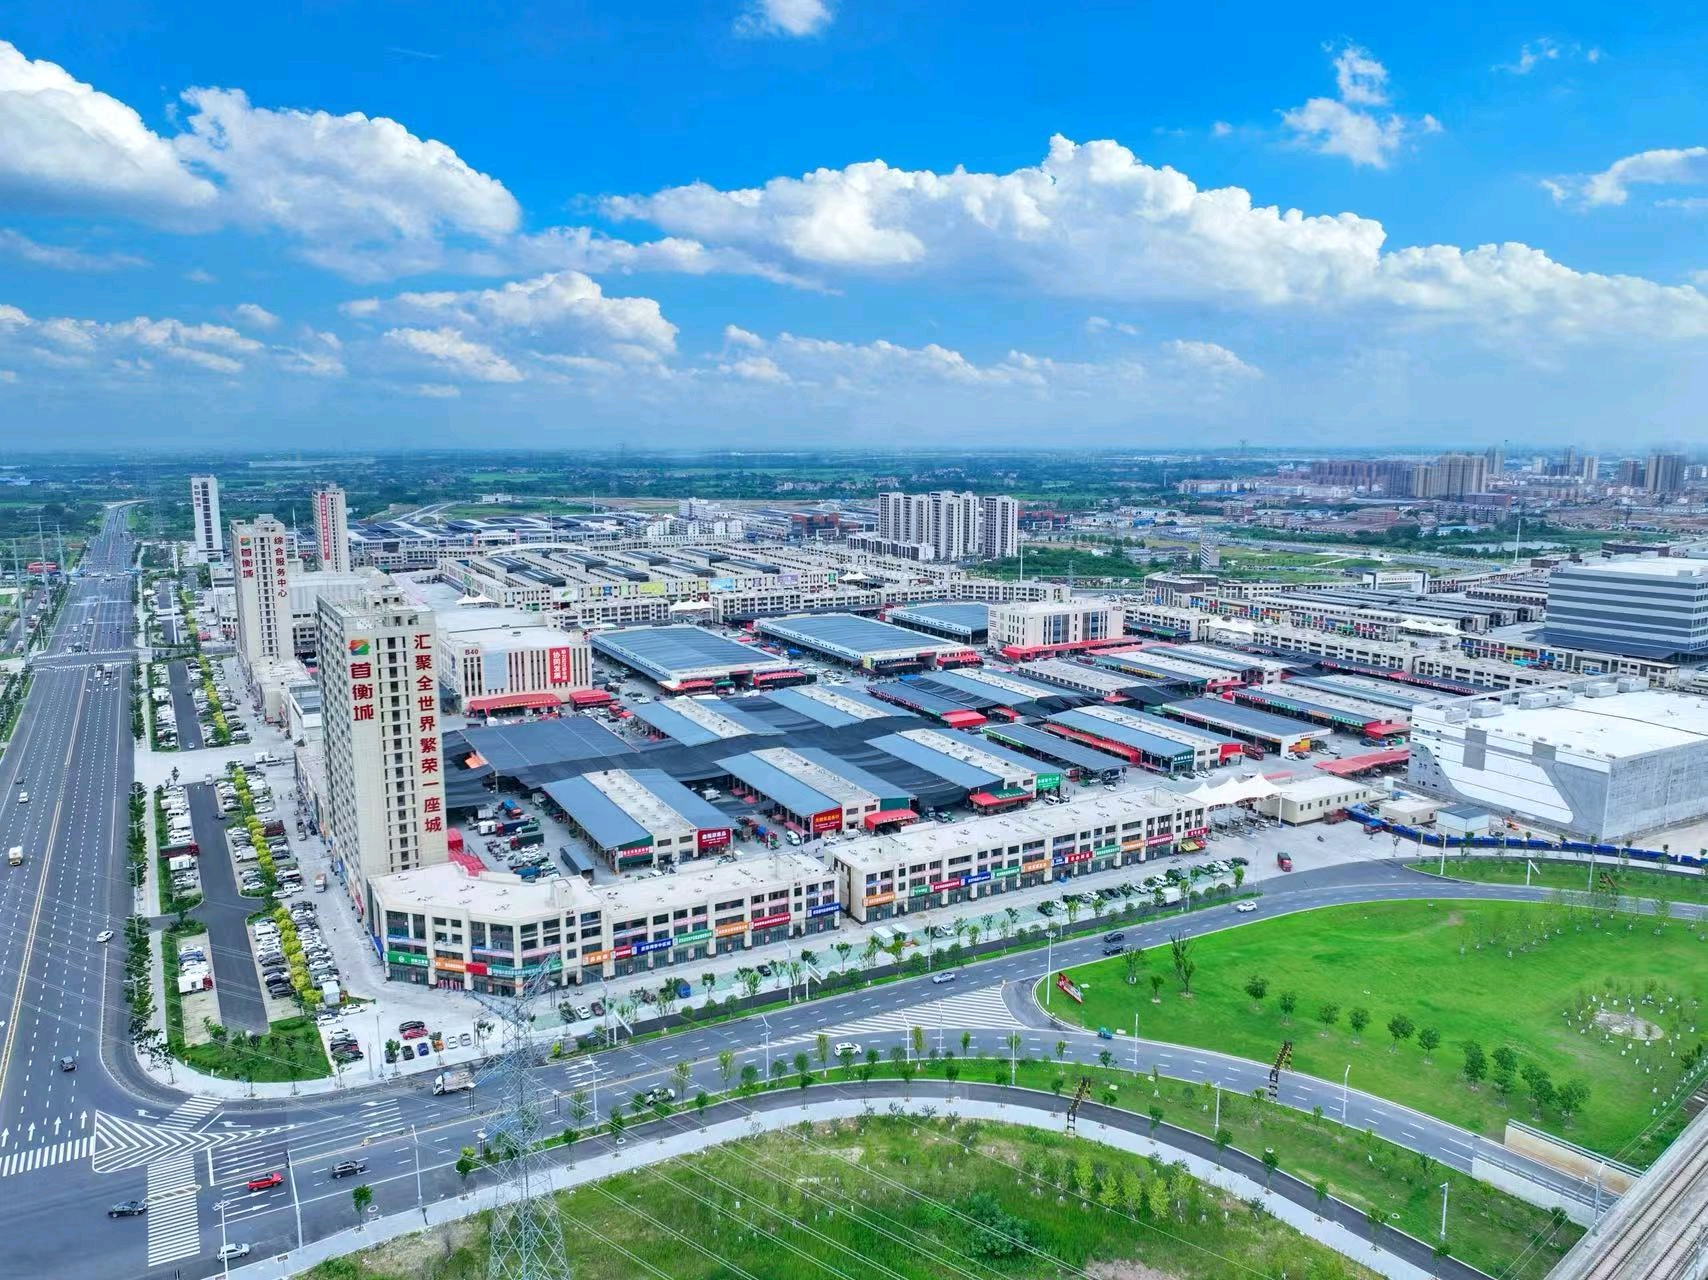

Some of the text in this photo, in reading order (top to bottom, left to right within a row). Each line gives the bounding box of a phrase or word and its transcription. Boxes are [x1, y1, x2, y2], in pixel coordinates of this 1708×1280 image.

[273, 536, 288, 598] 综合服务中心
[350, 662, 375, 722] 首衡城
[413, 634, 442, 834] 汇聚全世界繁荣一座城
